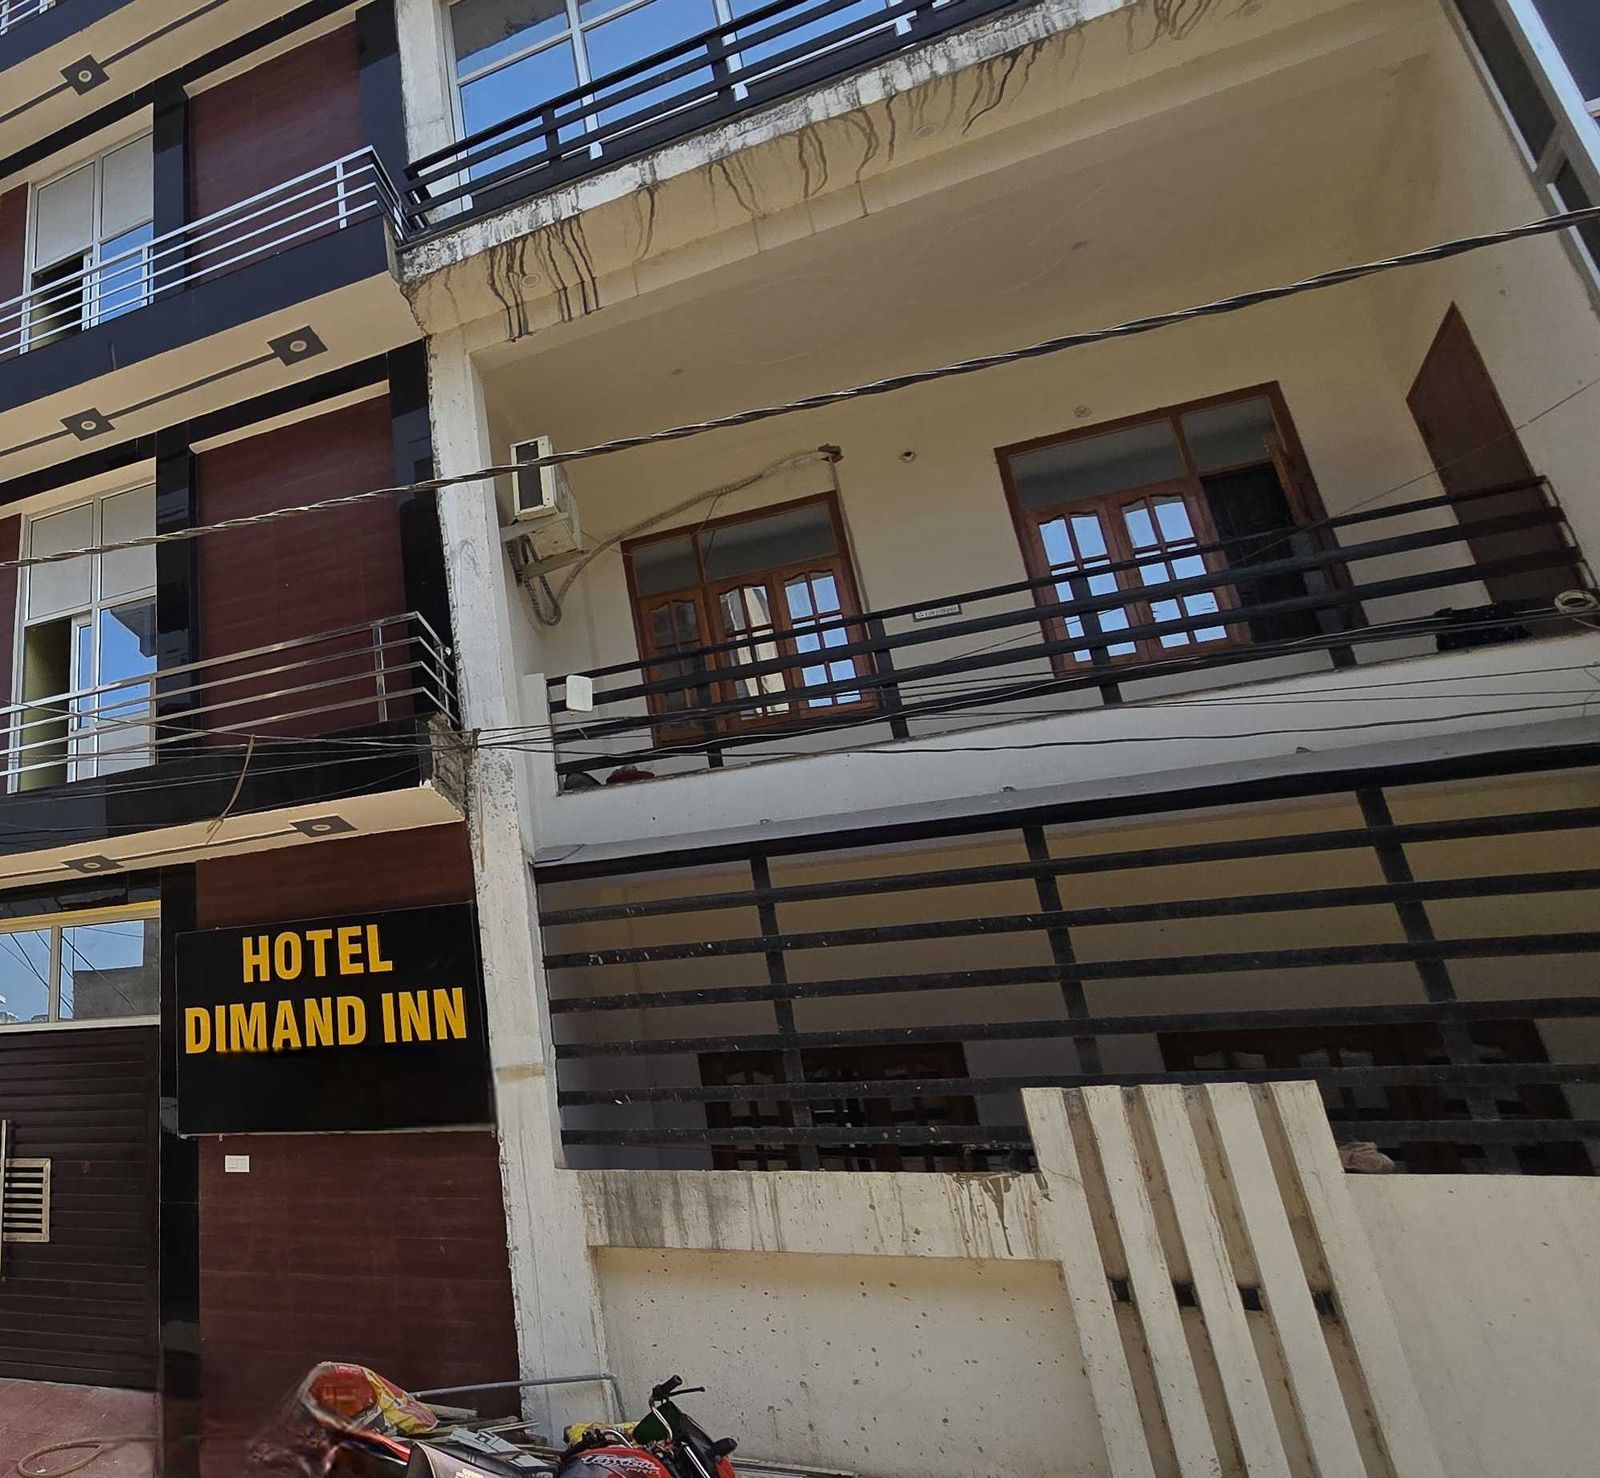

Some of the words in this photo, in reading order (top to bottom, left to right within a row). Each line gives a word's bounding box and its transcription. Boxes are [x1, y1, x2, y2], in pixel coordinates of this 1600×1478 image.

[242, 924, 393, 983] HOTEL
[184, 995, 367, 1054] DIMAND
[381, 987, 467, 1043] INN
